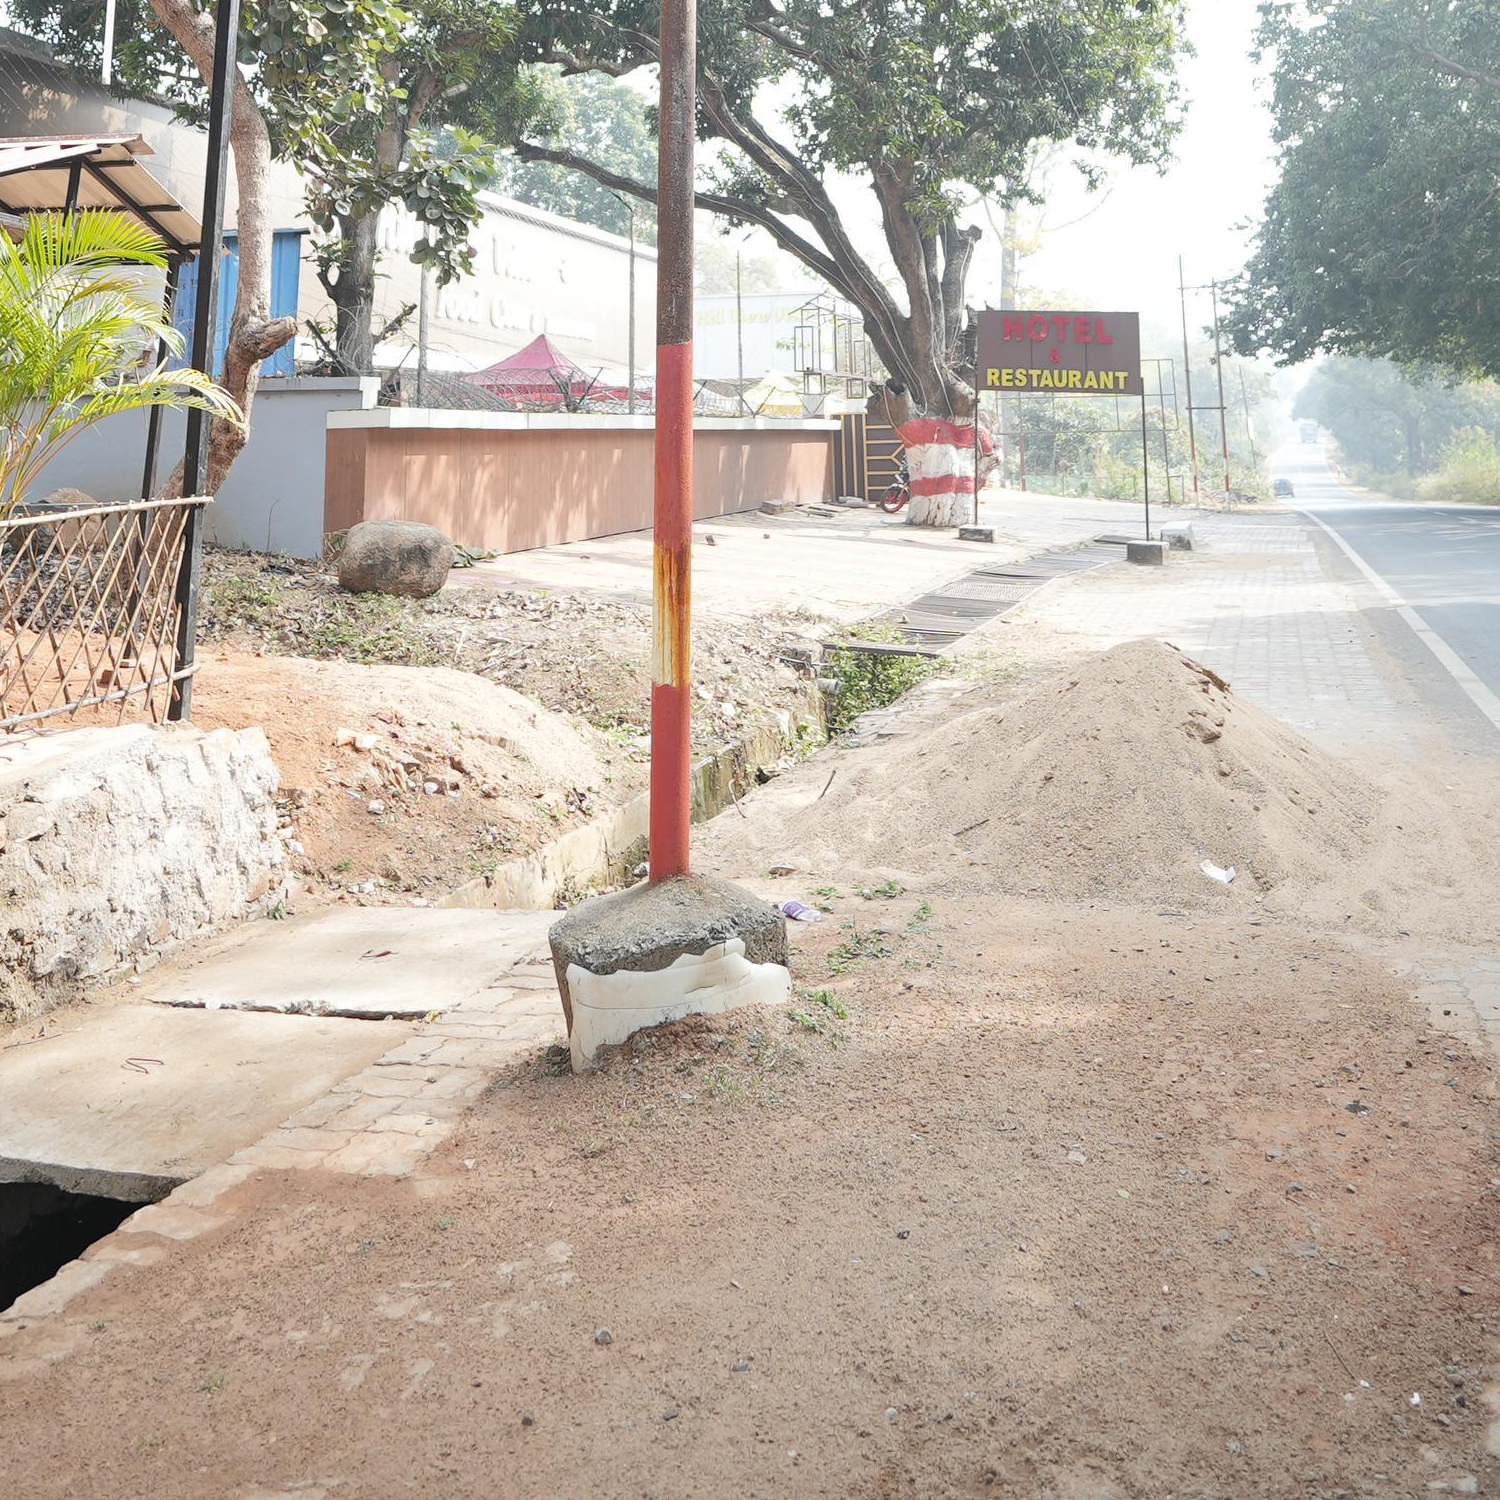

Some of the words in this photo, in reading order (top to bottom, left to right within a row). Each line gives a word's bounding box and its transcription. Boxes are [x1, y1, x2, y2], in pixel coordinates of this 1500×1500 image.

[1003, 314, 1115, 344] HOTEL
[1049, 348, 1060, 363] &
[986, 367, 1129, 389] RESTAURANT
